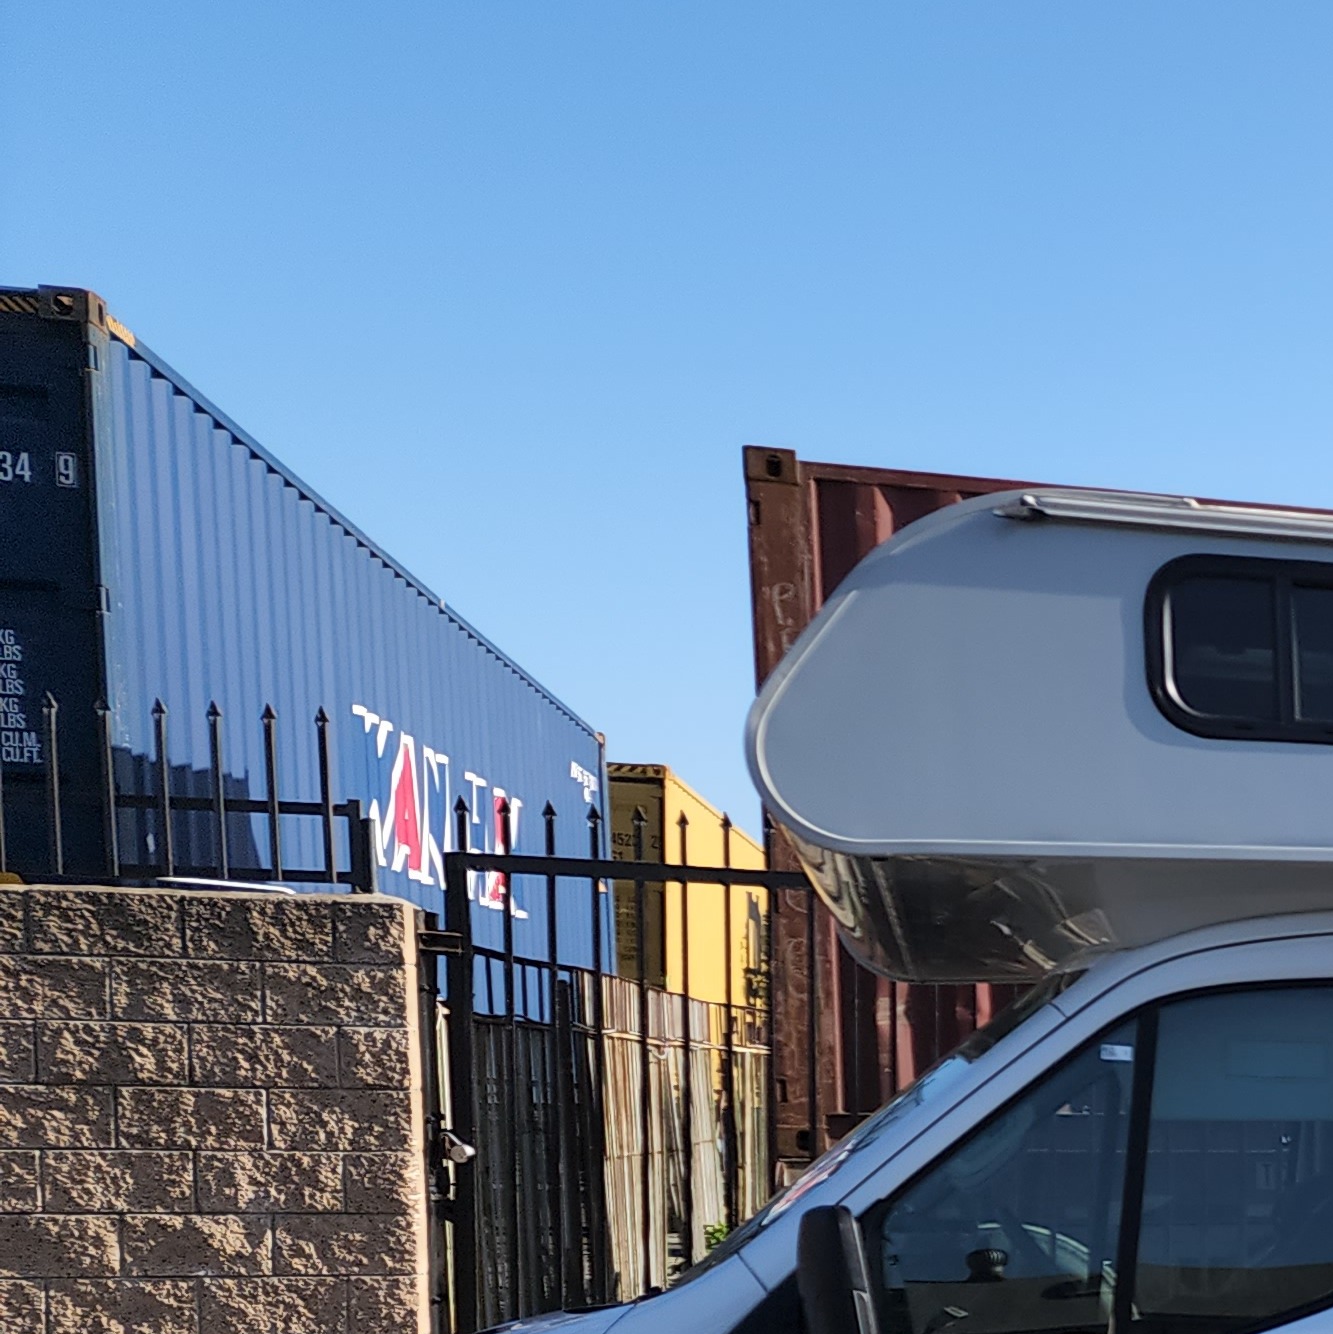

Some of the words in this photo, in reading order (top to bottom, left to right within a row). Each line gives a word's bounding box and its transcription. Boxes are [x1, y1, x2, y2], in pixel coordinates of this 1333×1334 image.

[59, 455, 74, 485] 9
[0, 697, 19, 713] KG
[0, 713, 27, 729] LBS
